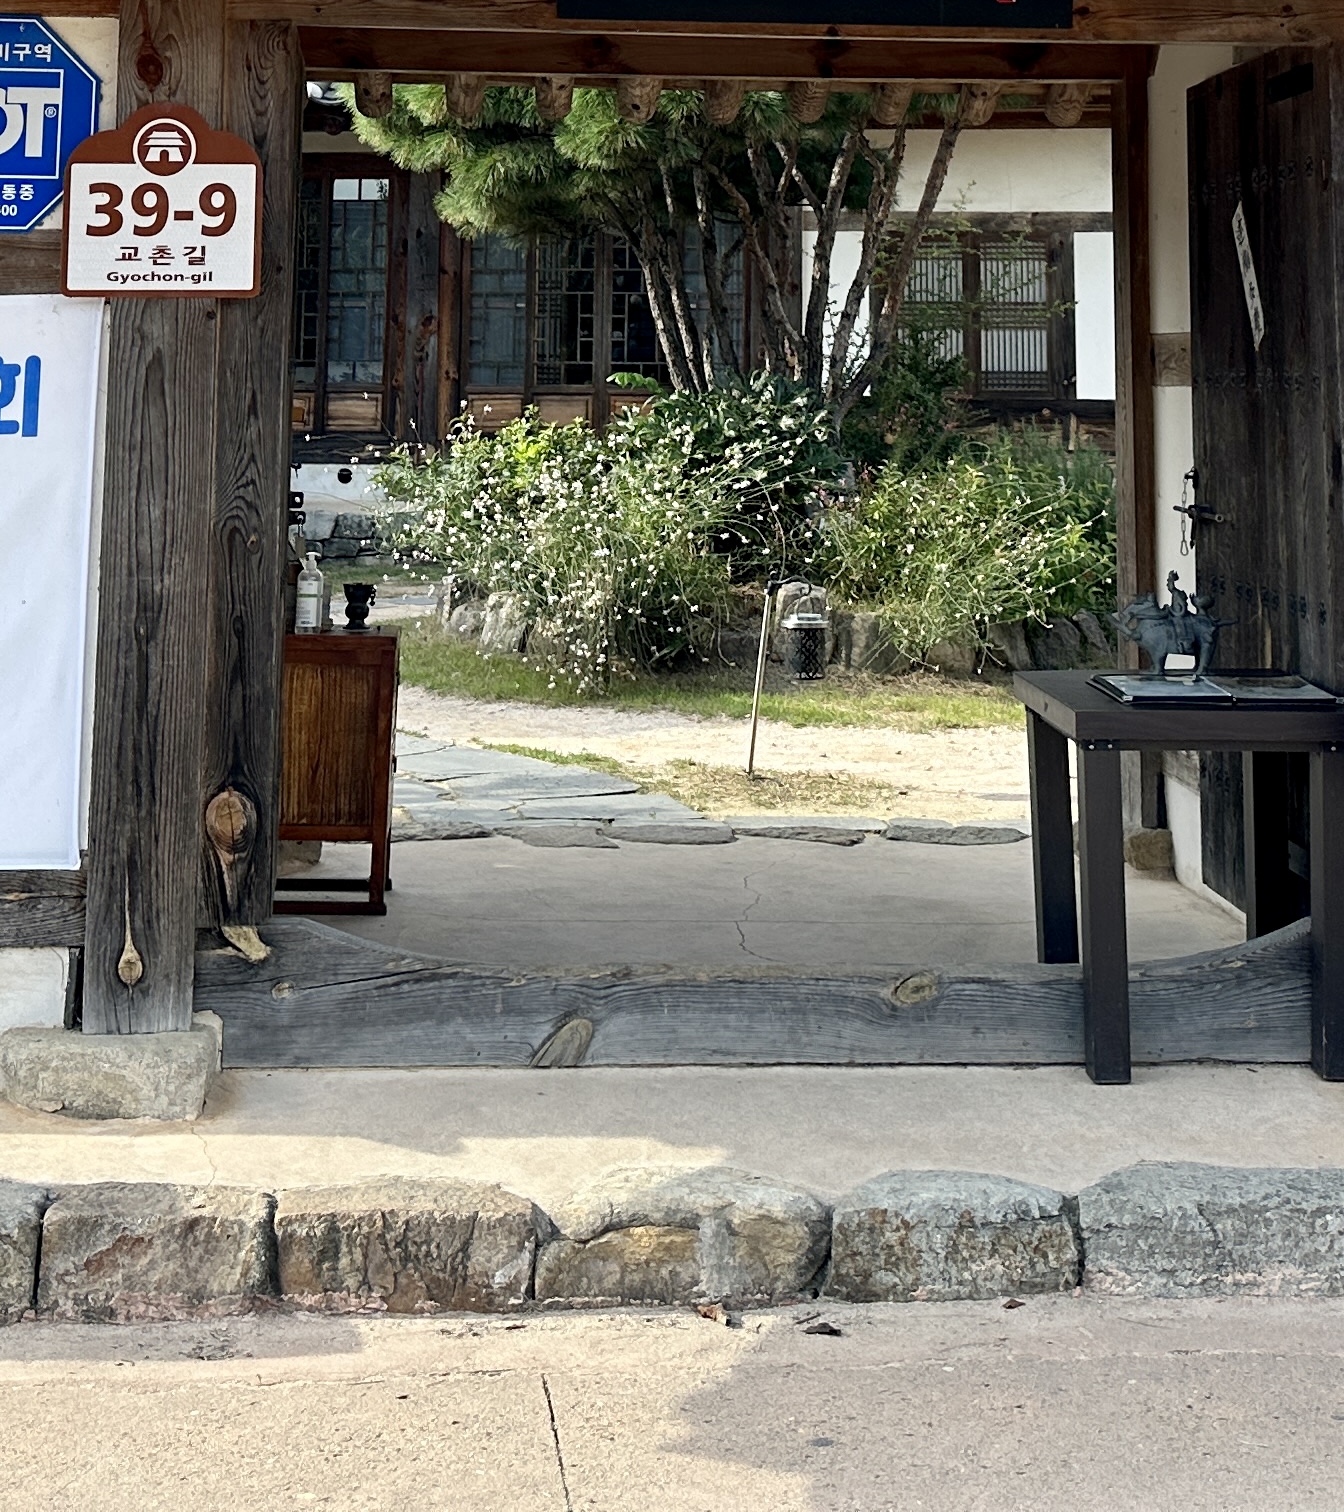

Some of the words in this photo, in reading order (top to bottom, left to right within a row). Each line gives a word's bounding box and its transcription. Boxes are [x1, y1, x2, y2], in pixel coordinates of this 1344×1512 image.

[85, 182, 238, 237] 39-9
[114, 244, 207, 266] 교촌길
[106, 271, 213, 285] Gyochon-gil
